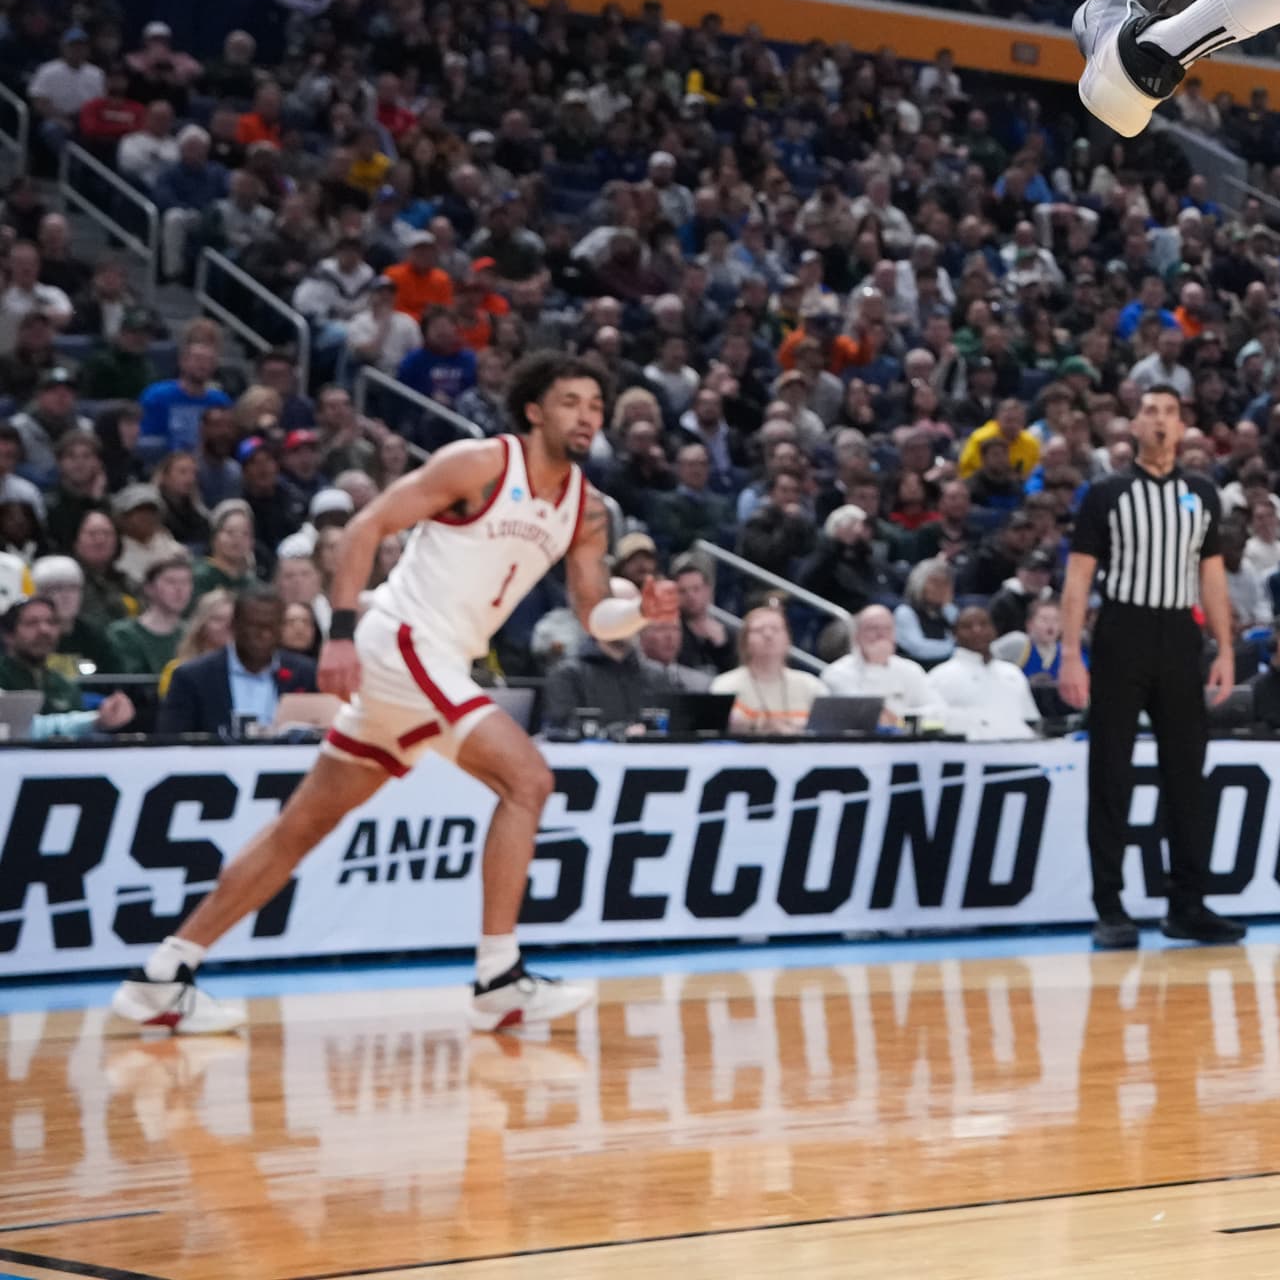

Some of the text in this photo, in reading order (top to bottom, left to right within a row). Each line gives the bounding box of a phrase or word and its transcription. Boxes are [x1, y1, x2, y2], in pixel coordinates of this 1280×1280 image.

[491, 563, 518, 607] 1
[338, 816, 477, 887] AND
[517, 761, 1053, 928] SECOND
